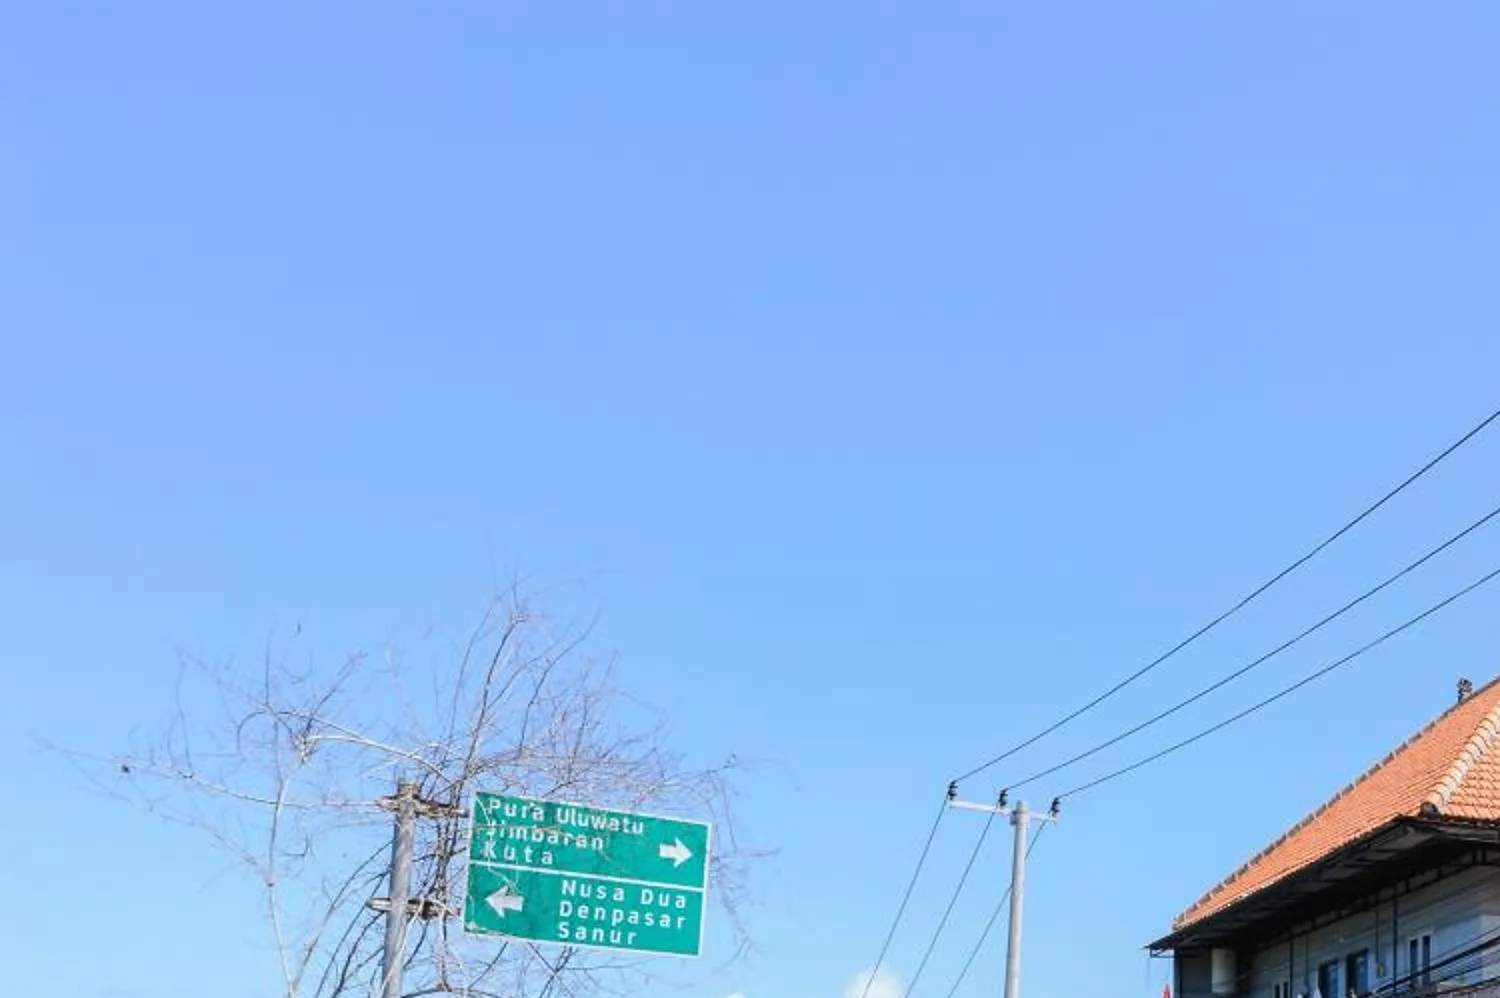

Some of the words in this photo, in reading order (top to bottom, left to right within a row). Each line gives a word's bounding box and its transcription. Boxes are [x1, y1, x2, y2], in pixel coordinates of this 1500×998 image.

[489, 798, 544, 821] Pura
[556, 808, 644, 833] Uluwatu
[482, 840, 553, 864] Kuta
[561, 880, 625, 901] Nusa
[640, 889, 686, 908] Dua
[559, 901, 686, 928] Denpasar
[558, 922, 638, 944] Sanur
